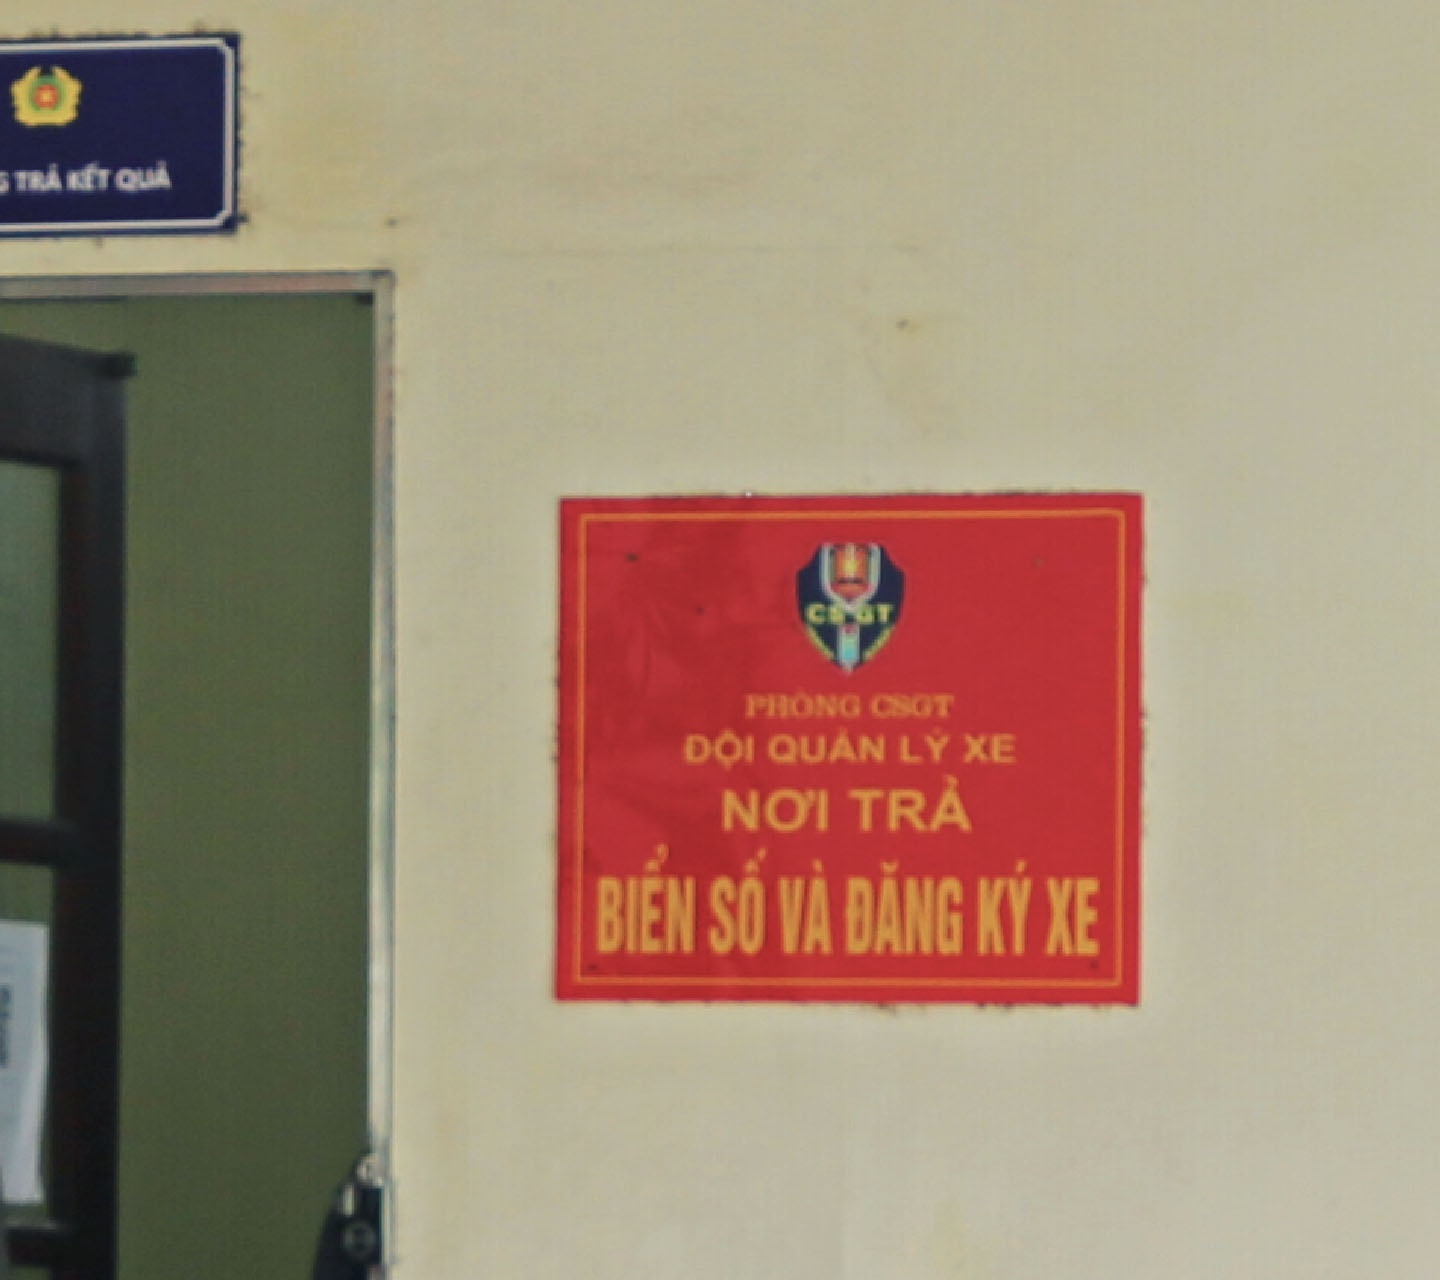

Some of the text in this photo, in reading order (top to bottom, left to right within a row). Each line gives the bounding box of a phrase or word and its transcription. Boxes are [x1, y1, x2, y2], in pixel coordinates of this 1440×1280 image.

[15, 163, 62, 191] TRẢ
[66, 160, 110, 191] KẾT
[115, 160, 172, 193] QUẢ
[745, 689, 954, 719] PHÒNG CSGT
[684, 726, 1016, 770] ĐỘI QUẢN LÝ XE
[722, 774, 972, 832] NƠI TRẢ
[597, 843, 1100, 956] BIỂN SỐ VÀ ĐĂNG KÝ XE
